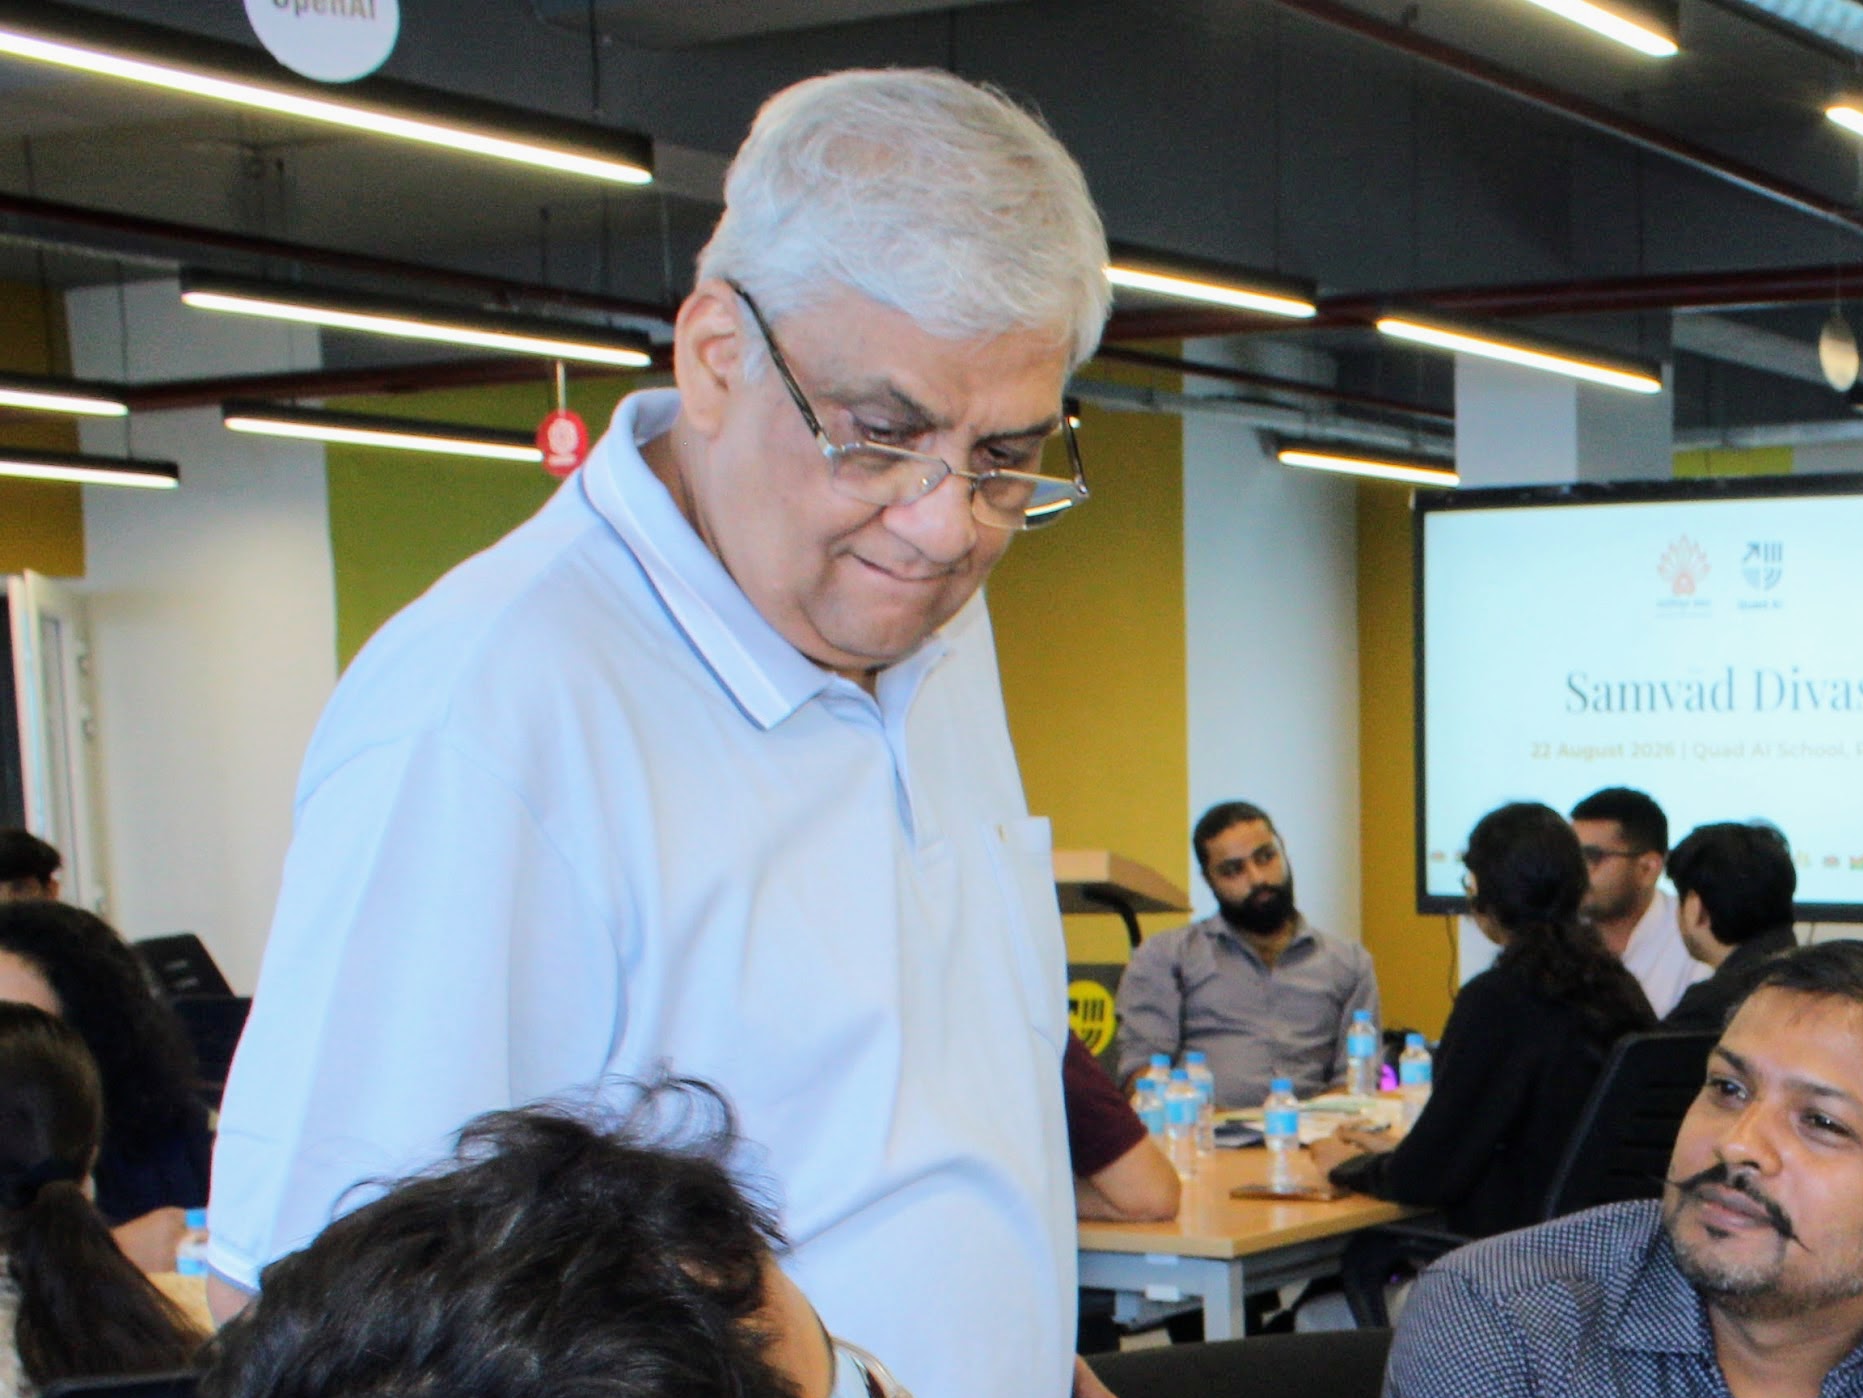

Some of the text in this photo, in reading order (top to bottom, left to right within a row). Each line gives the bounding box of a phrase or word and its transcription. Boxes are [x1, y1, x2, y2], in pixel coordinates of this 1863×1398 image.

[1530, 743, 1551, 760] 22
[1557, 742, 1625, 763] August
[1631, 742, 1677, 760] 2026
[1692, 742, 1745, 761] Quad
[1776, 741, 1851, 761] School,
